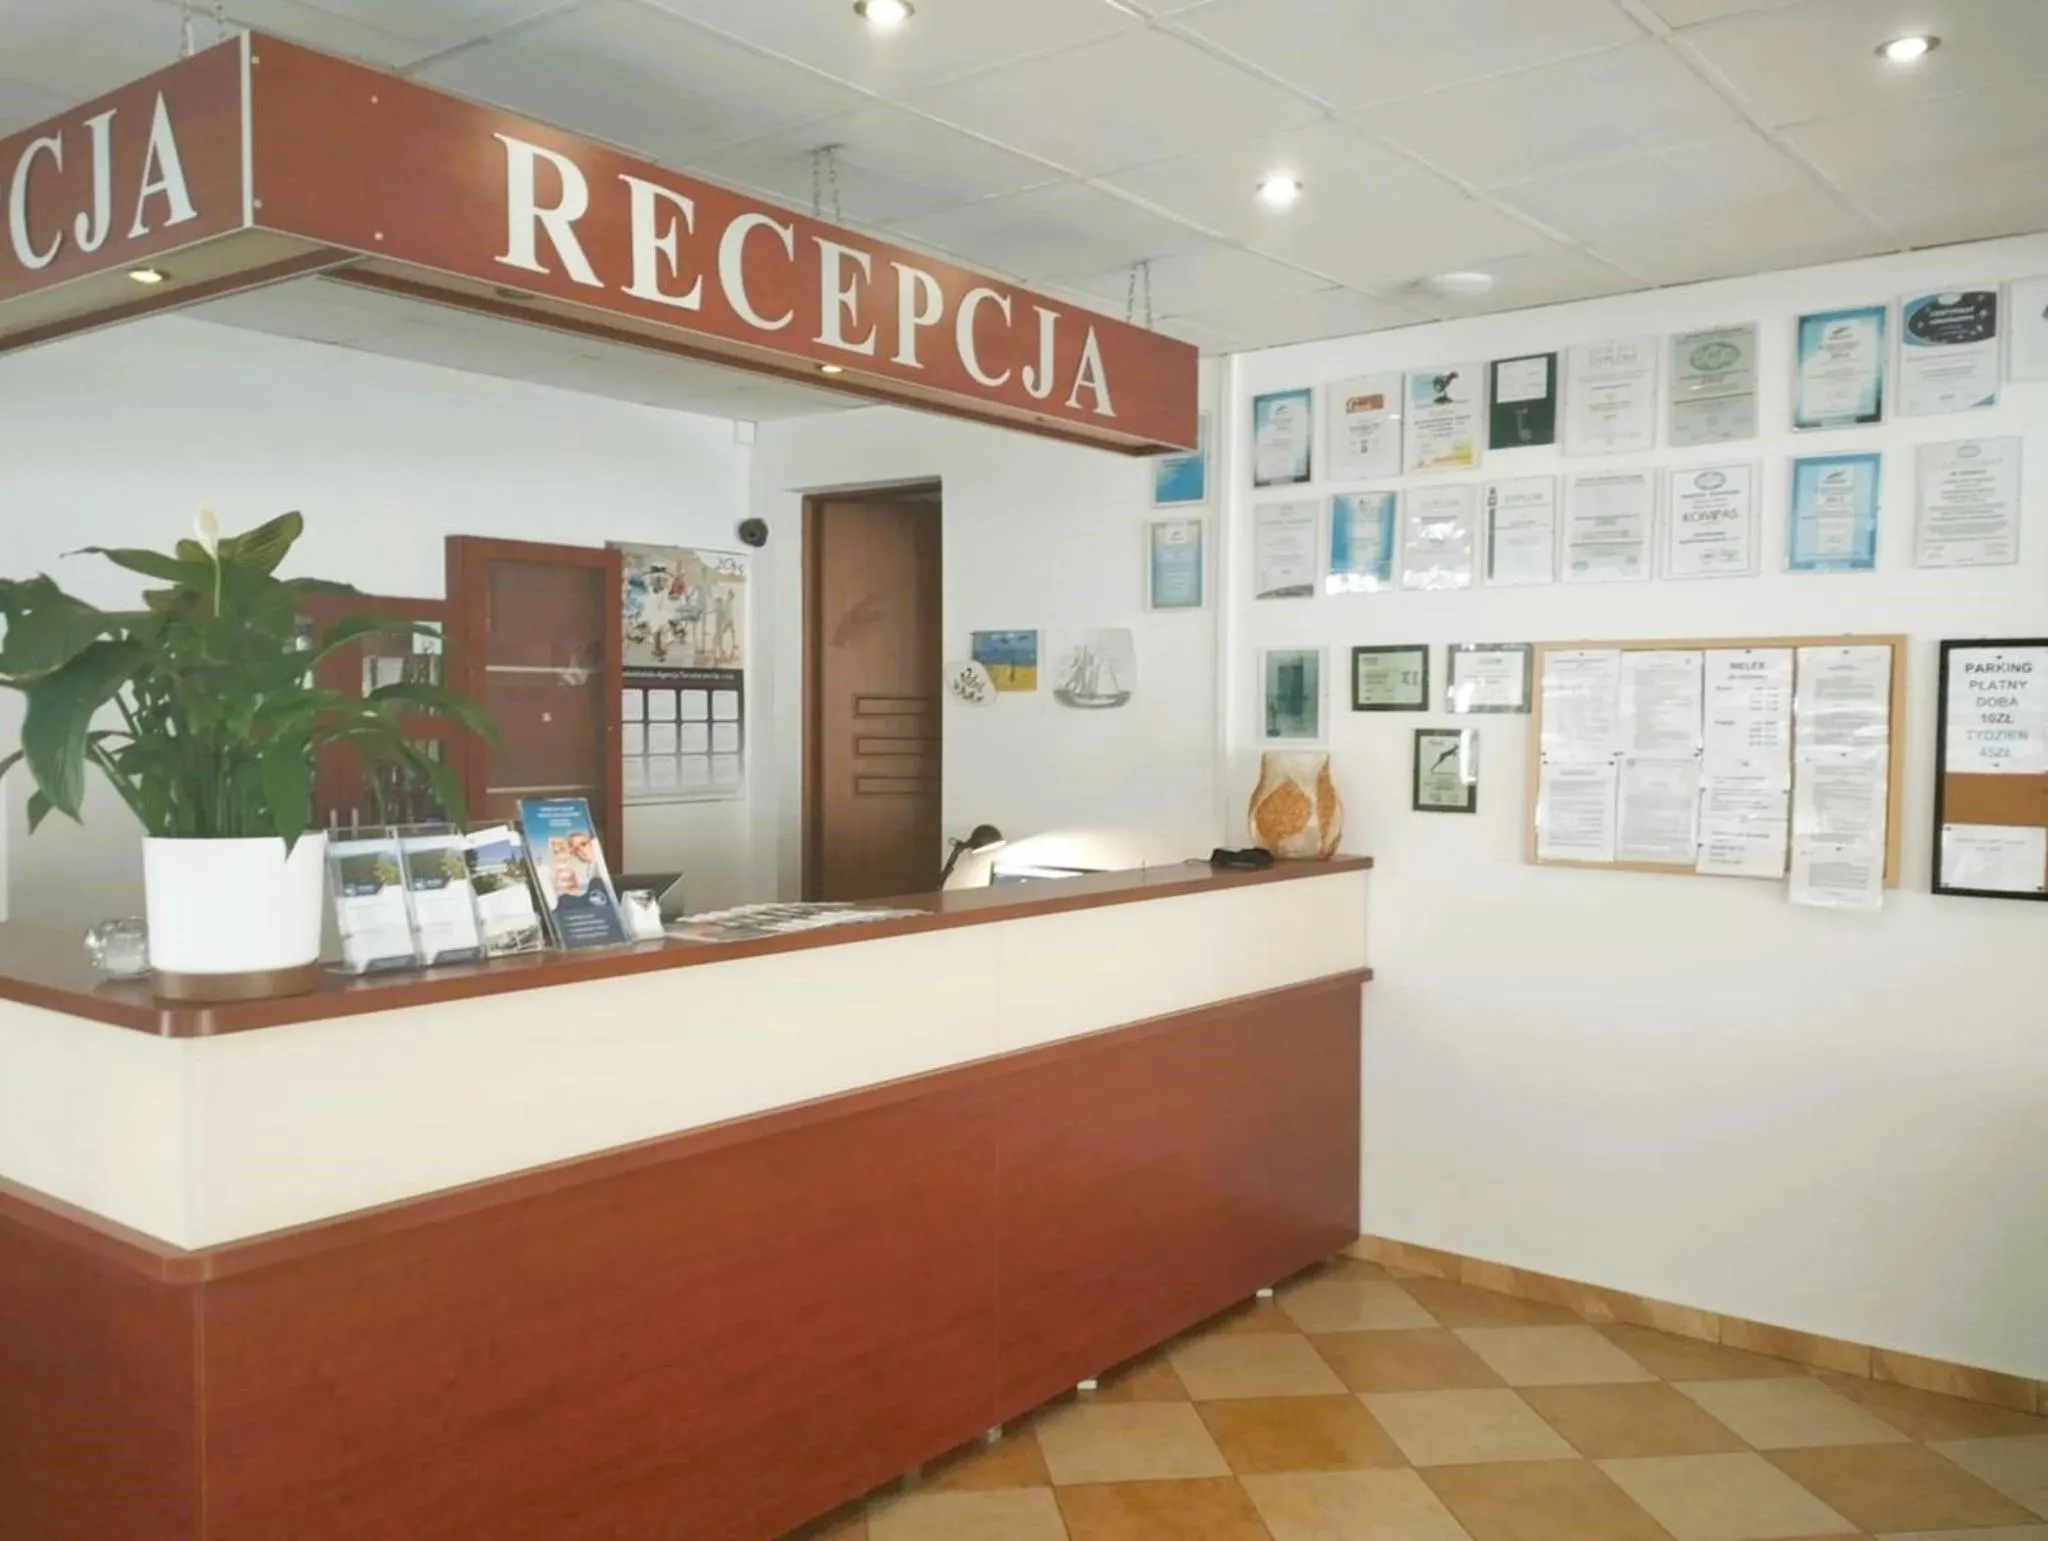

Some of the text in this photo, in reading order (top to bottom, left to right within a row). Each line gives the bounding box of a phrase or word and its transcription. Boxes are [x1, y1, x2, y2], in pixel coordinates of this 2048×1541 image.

[0, 89, 198, 270] CJA
[491, 131, 1117, 419] RECEPCJA
[1964, 661, 2033, 674] PARKING
[1975, 696, 2019, 707] DOBA
